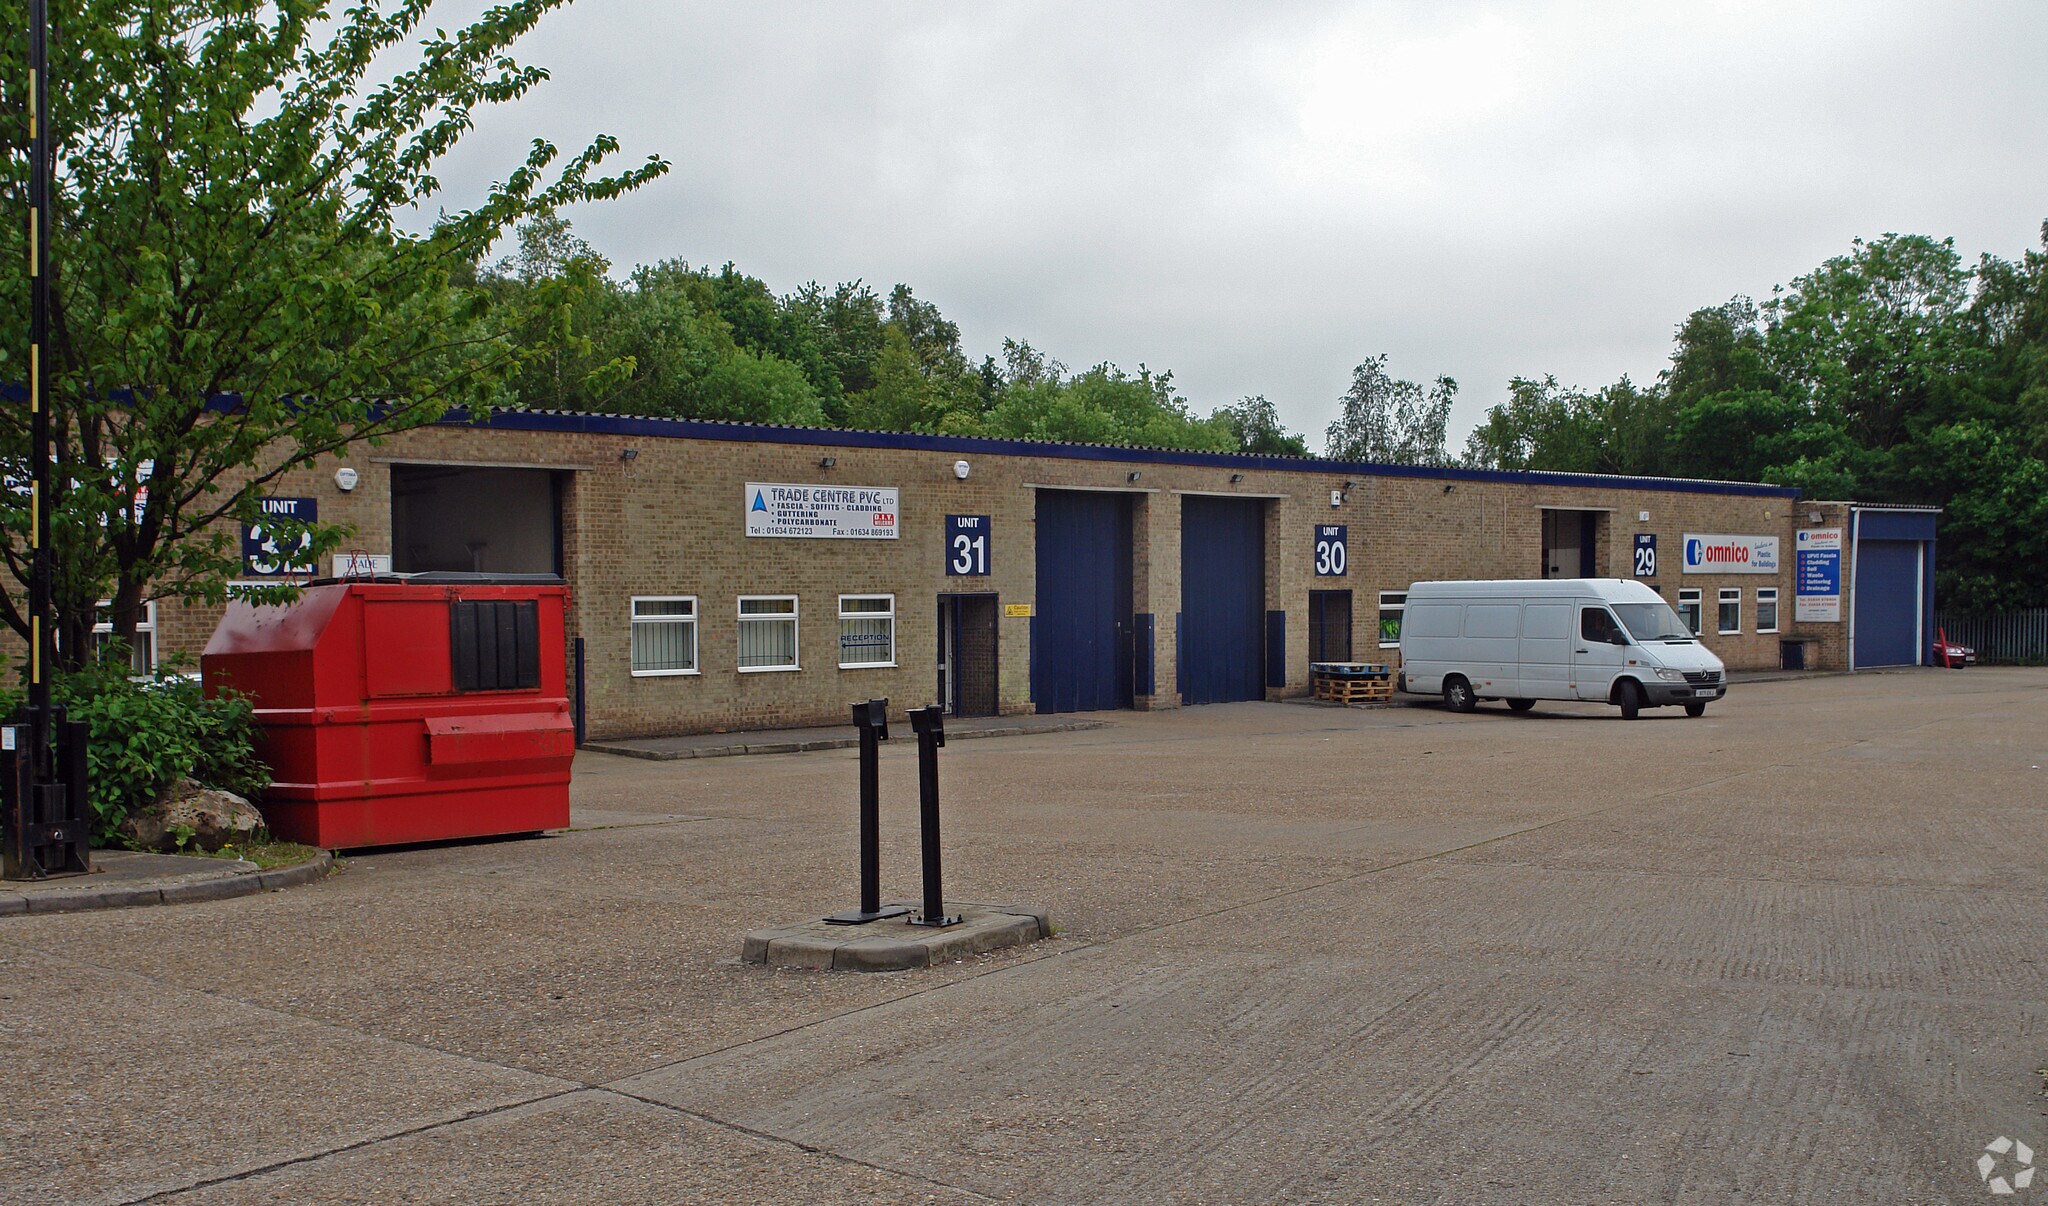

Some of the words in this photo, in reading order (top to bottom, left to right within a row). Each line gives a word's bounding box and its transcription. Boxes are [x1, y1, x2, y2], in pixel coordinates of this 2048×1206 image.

[771, 488, 809, 502] TRADE
[813, 489, 856, 504] CENTRE
[860, 491, 881, 504] PVC
[262, 500, 298, 514] UNIT
[777, 502, 804, 510] FASCIA
[811, 503, 840, 511] SOFFITS
[847, 504, 882, 512] CLADDING
[777, 510, 819, 518] GUTTERING
[777, 518, 837, 526] POLYCARBONATE
[957, 517, 979, 528] UNIT
[750, 526, 761, 534] Tel
[789, 527, 813, 535] 672123
[850, 528, 870, 536] 01634
[1323, 526, 1339, 536] UNIT
[1811, 531, 1838, 540] omnico
[1639, 535, 1651, 543] UNIT
[953, 534, 985, 574] 31
[1706, 541, 1749, 563] omnico
[1316, 541, 1346, 574] 30
[1635, 547, 1655, 576] 29
[346, 559, 378, 569] TRADE
[840, 634, 890, 642] RECEPTION
